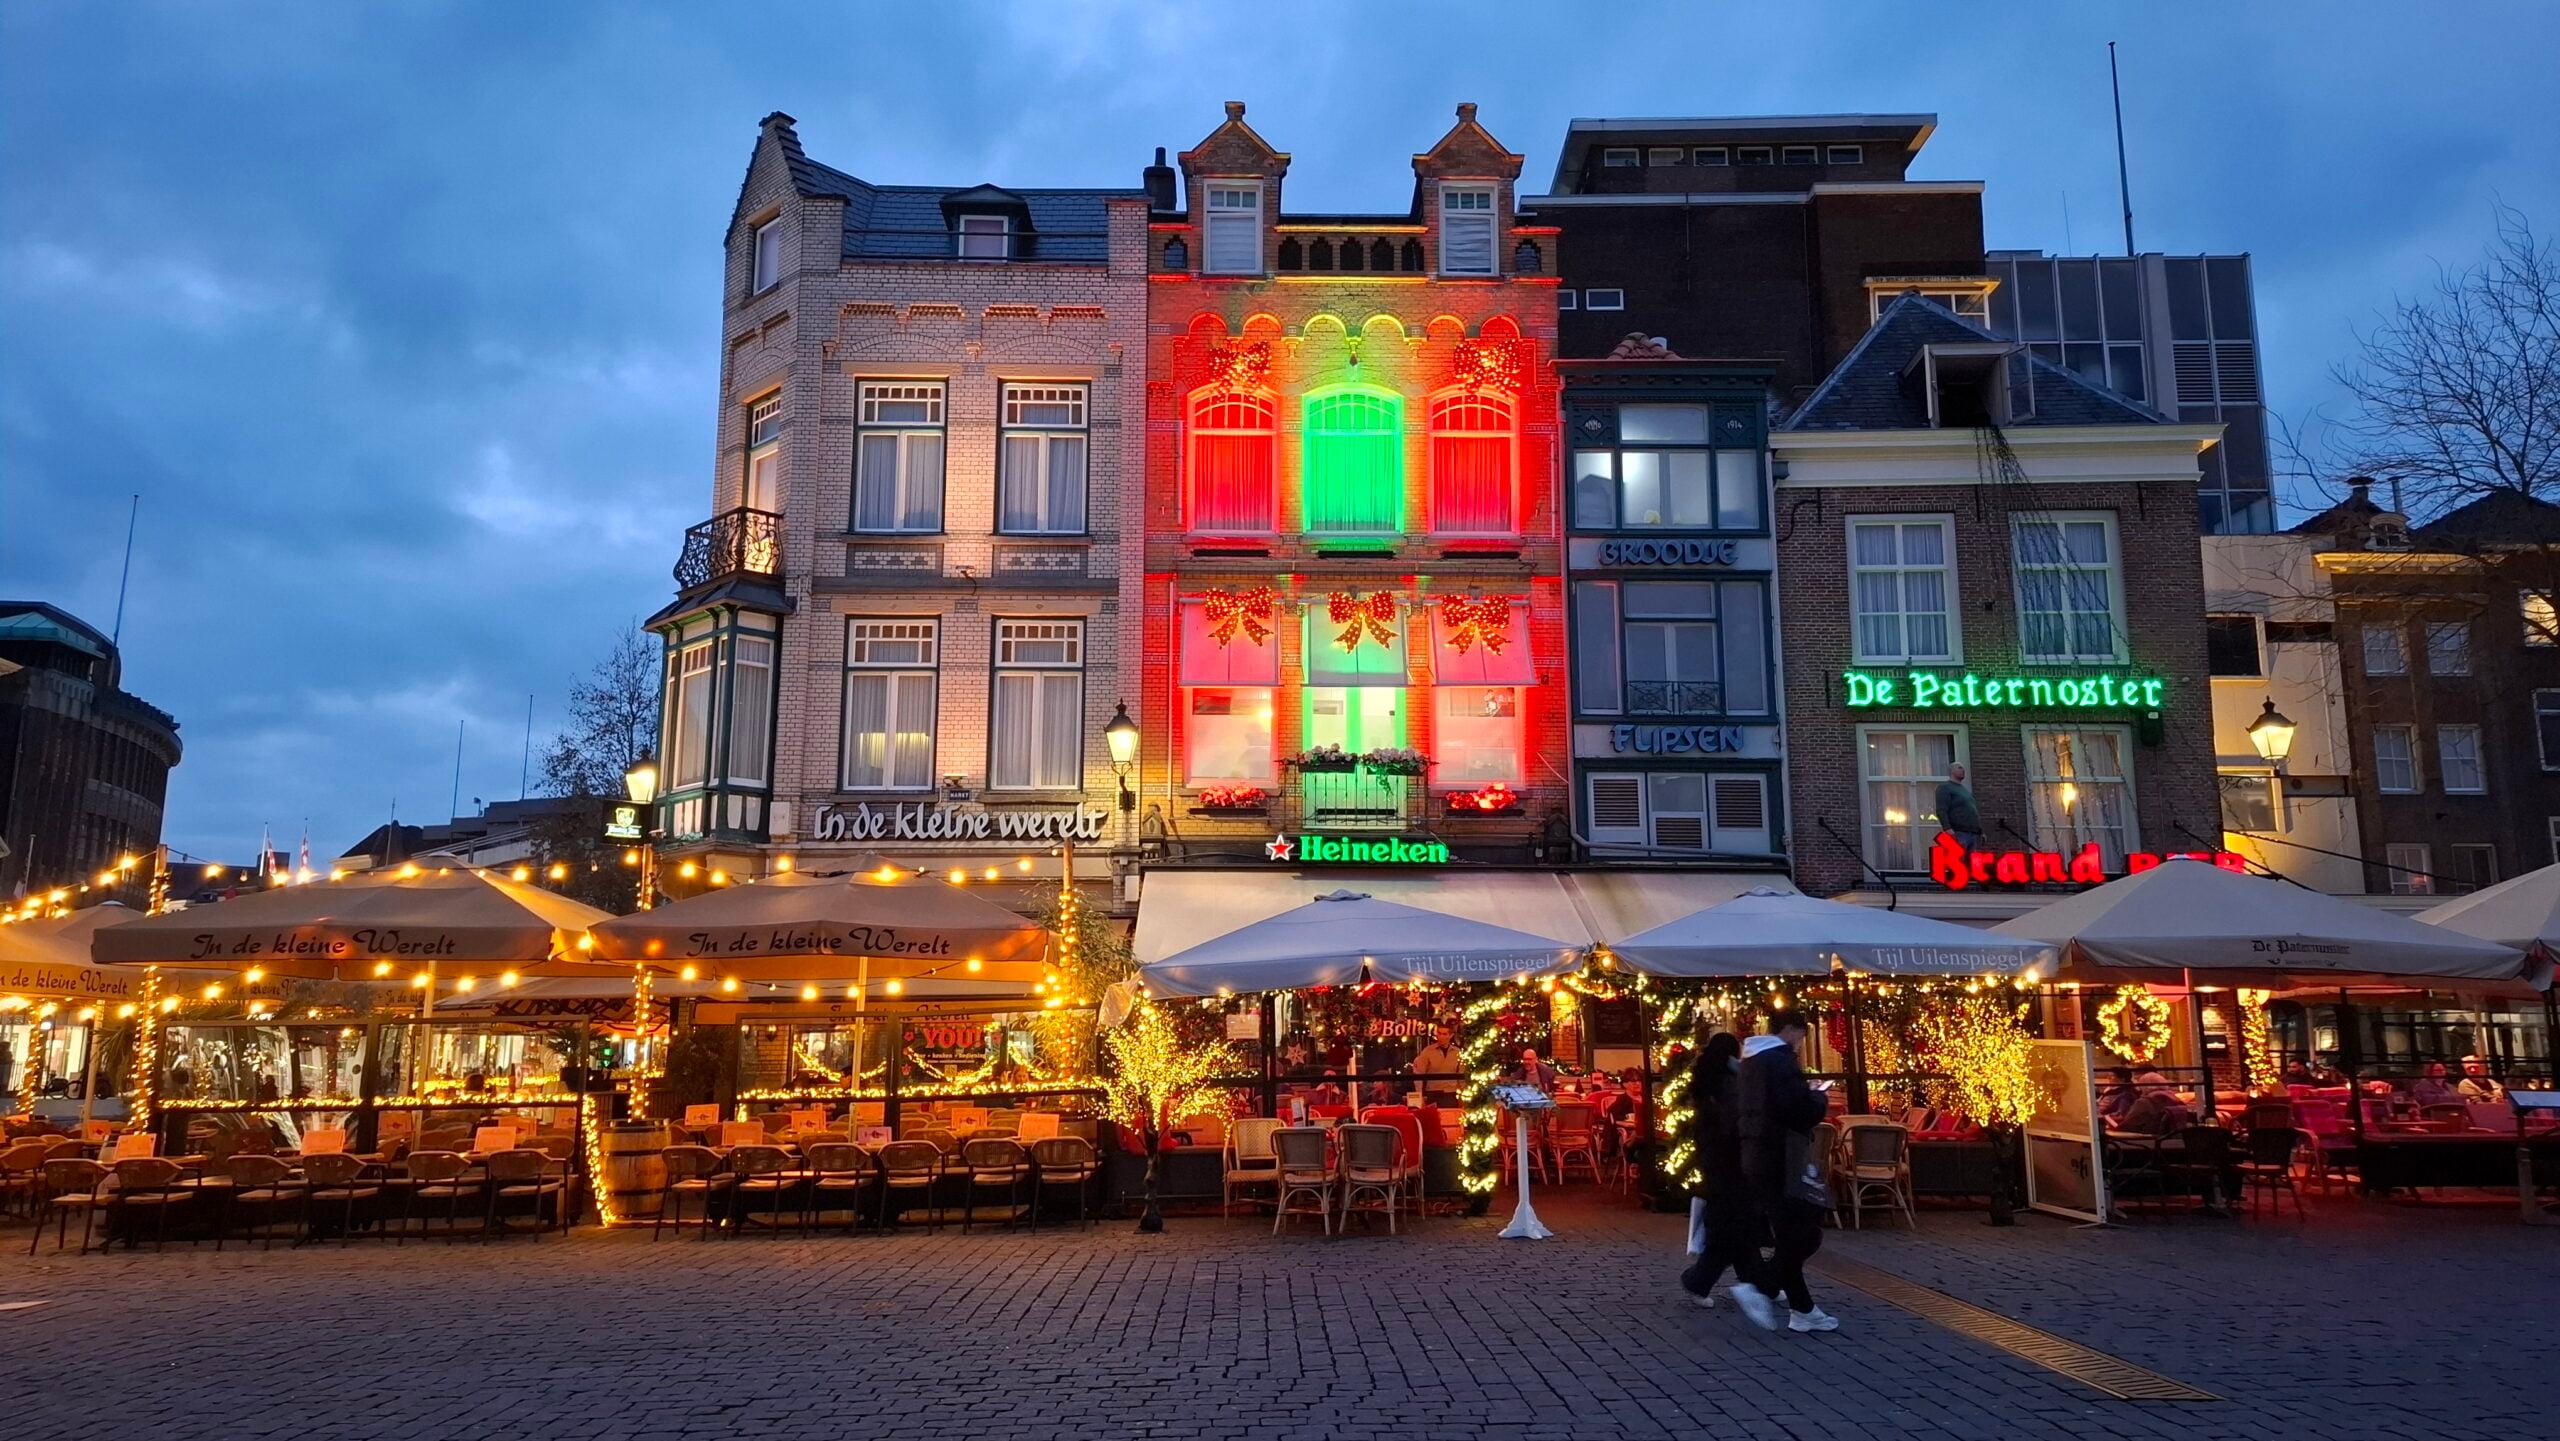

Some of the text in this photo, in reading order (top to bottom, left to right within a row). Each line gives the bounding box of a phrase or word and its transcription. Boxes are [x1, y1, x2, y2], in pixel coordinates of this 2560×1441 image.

[1727, 420, 1743, 429] 1914
[1599, 538, 1738, 565] BROODJE
[1843, 672, 2163, 706] De Paternoster
[1610, 724, 1744, 755] FLIPSEN
[813, 802, 1108, 841] In de kleine werelt
[1299, 836, 1449, 862] Heineken
[1929, 830, 2105, 890] Brand
[190, 929, 456, 959] In de kleine Werelt
[686, 927, 951, 957] In de kleine Werelt
[2251, 940, 2271, 952] De
[1402, 953, 1550, 976] Tijl Uilenspiegel
[1872, 948, 2024, 971] Tijl Uilenspiegel
[11, 968, 29, 986] de
[35, 969, 77, 990] kleine
[80, 969, 127, 994] Werelt
